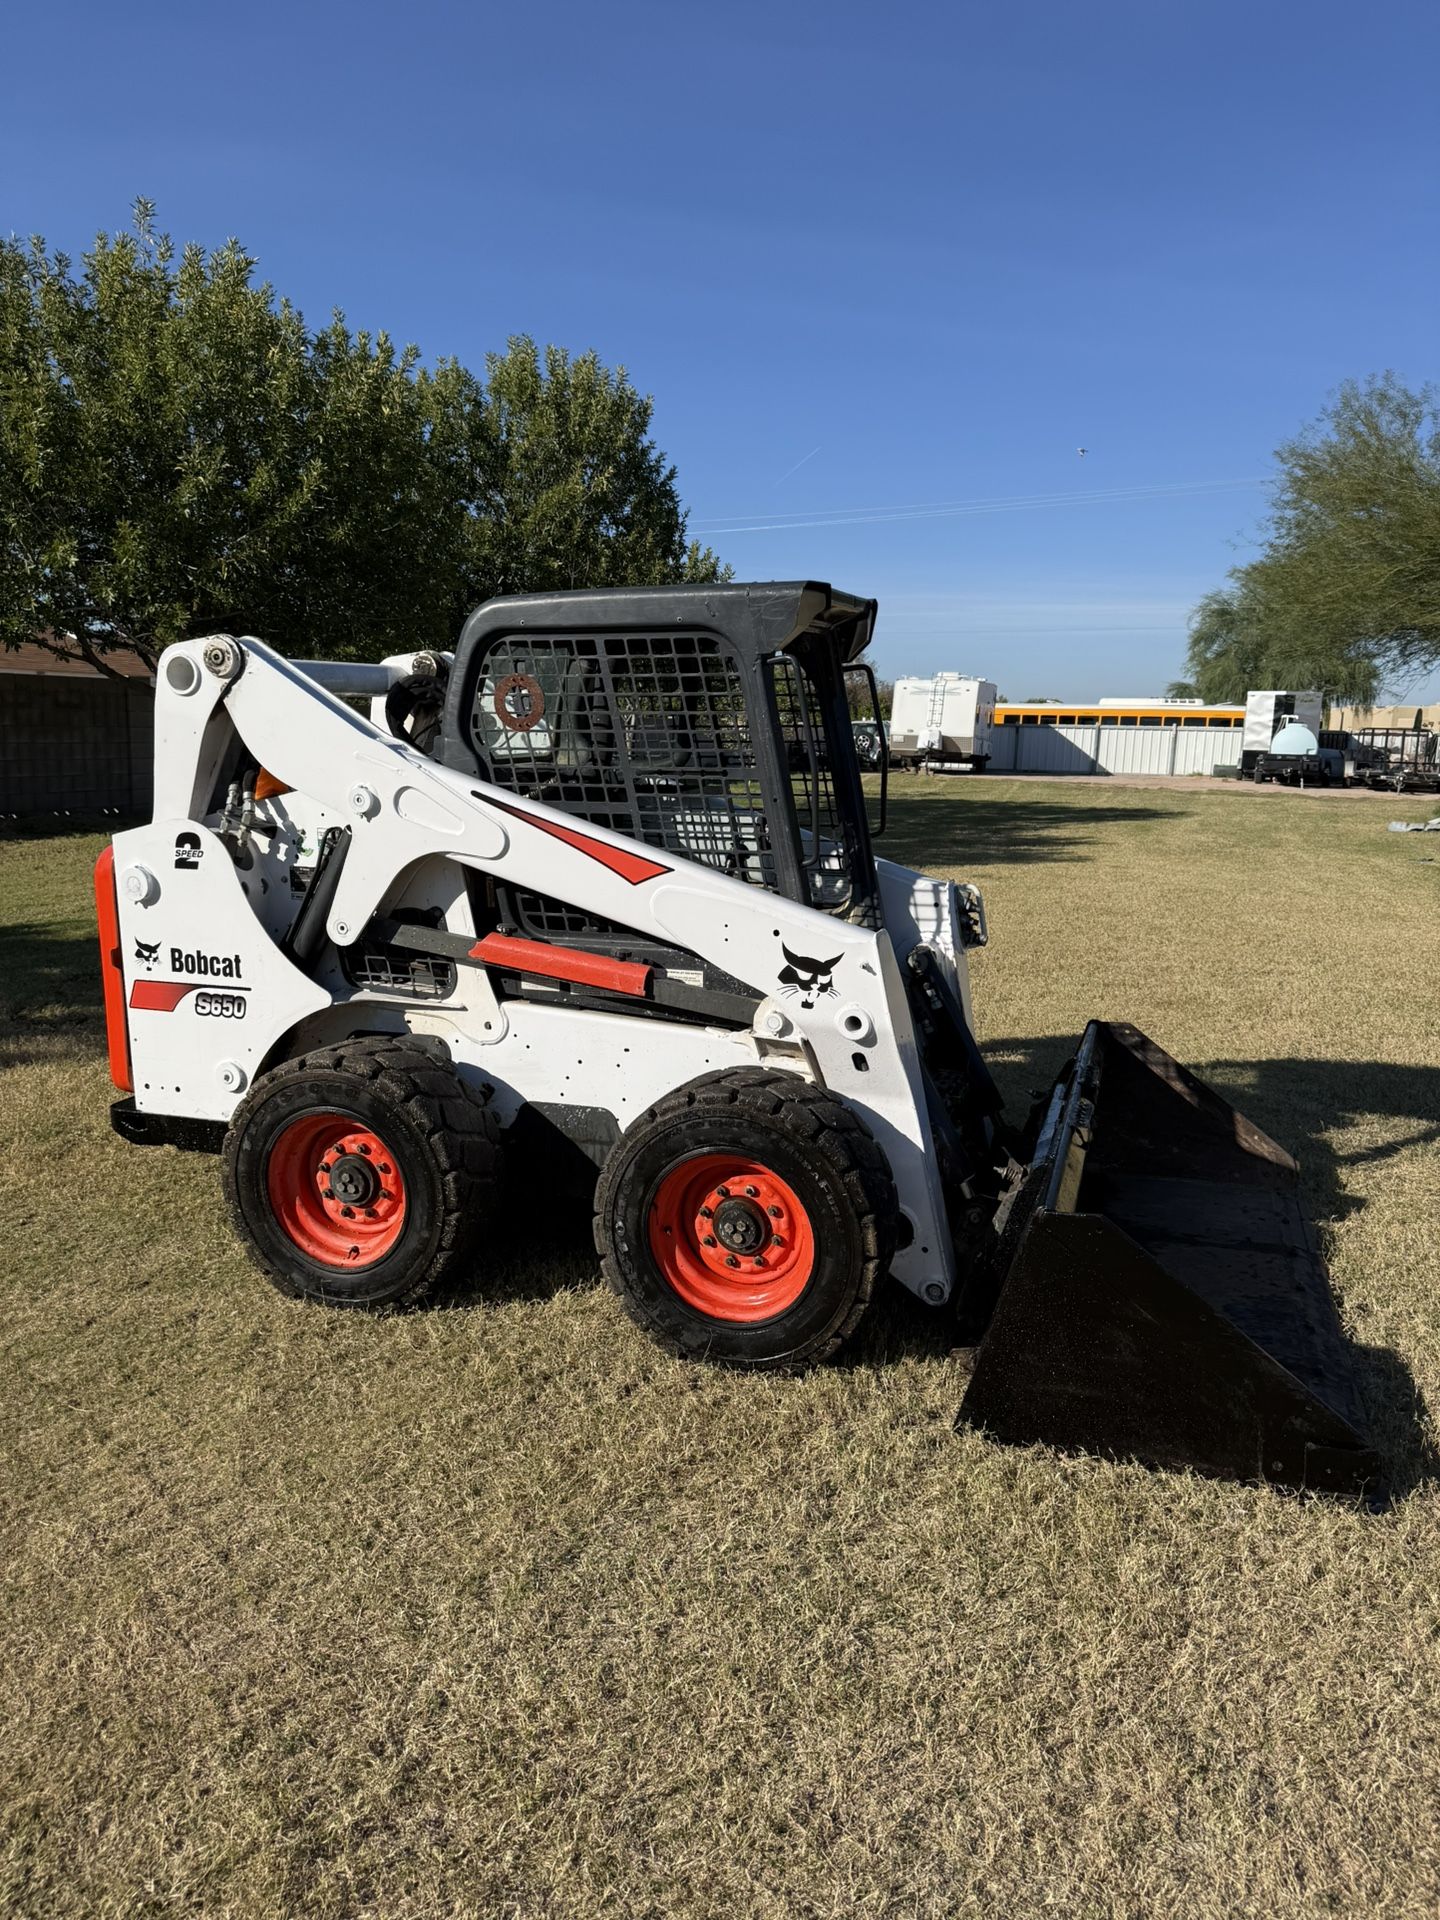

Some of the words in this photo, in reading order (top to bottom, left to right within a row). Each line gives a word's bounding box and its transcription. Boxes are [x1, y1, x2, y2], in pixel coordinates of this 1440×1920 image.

[175, 832, 201, 870] 2
[175, 849, 204, 858] SPEED
[170, 947, 242, 978] Bobcat
[195, 992, 246, 1019] S650
